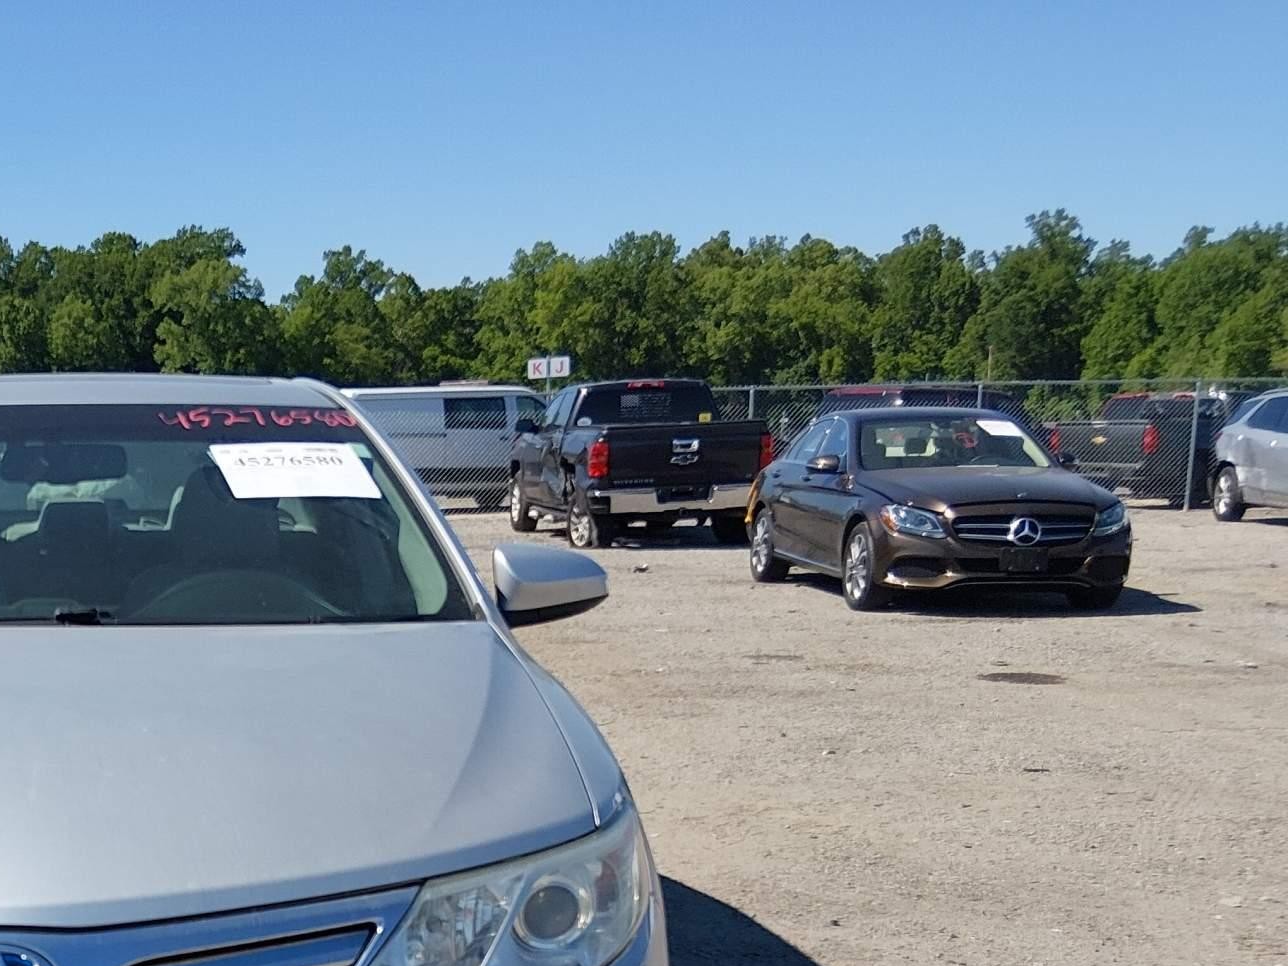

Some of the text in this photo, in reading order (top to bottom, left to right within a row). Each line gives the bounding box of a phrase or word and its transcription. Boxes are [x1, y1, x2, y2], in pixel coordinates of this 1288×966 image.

[532, 362, 542, 375] K
[555, 360, 564, 374] J
[233, 455, 344, 468] 45276580
